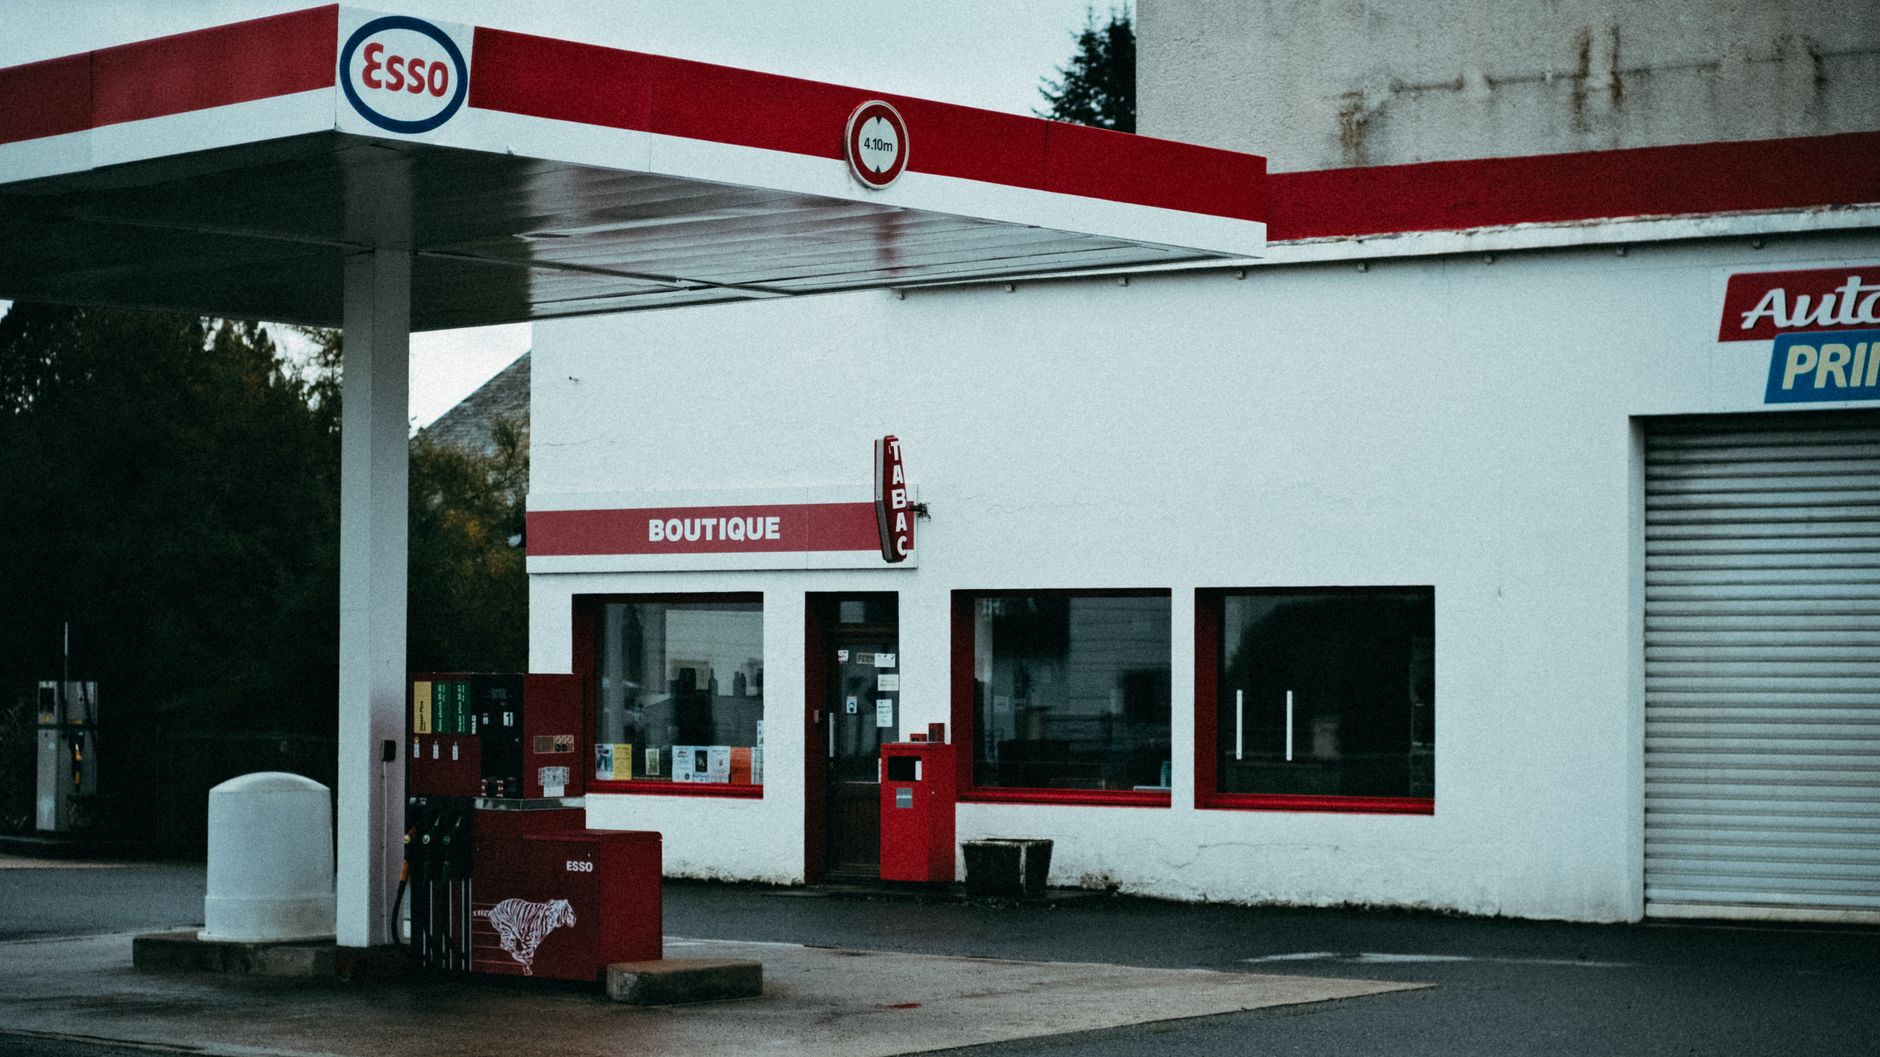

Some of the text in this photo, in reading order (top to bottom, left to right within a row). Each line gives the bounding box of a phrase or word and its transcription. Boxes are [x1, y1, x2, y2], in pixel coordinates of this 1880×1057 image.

[864, 137, 893, 152] 4.10m
[890, 440, 908, 556] TABAC
[648, 516, 780, 543] BOUTIQUE
[566, 860, 593, 873] ESSO
